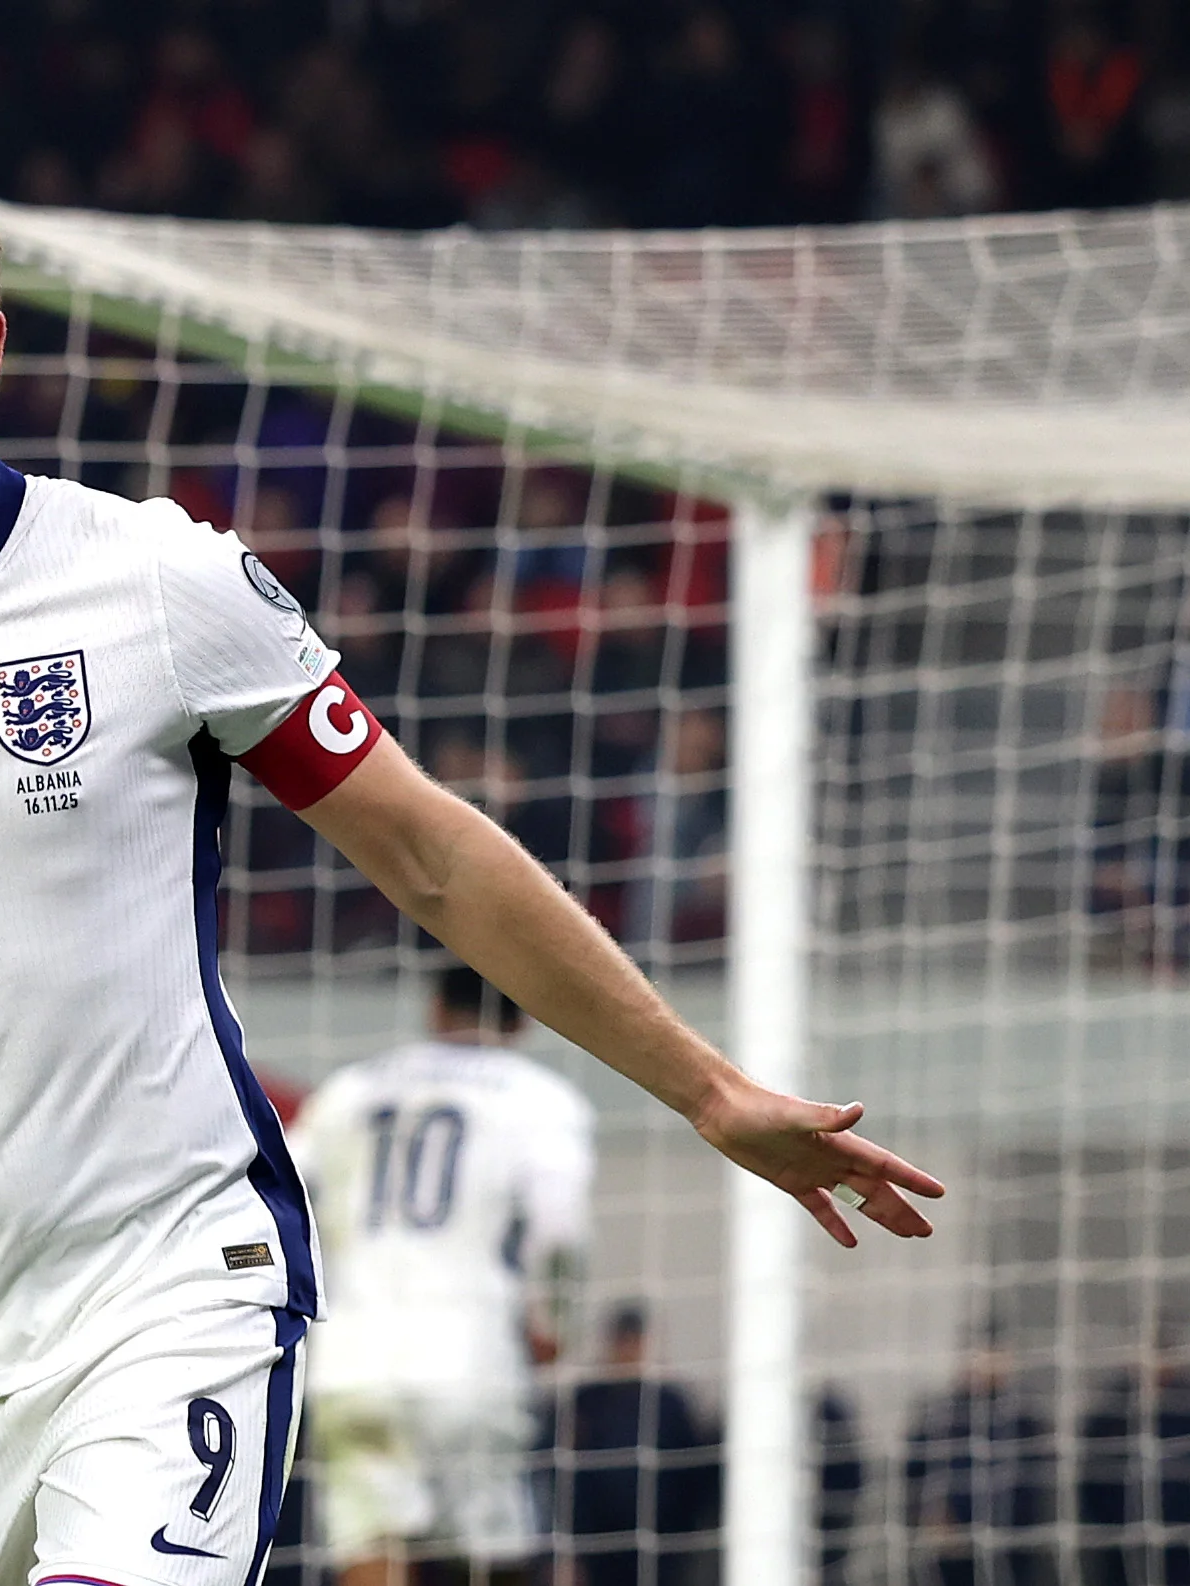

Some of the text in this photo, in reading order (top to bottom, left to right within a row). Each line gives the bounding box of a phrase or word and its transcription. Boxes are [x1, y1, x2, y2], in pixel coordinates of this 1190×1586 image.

[308, 685, 369, 755] C
[16, 770, 82, 794] ALBANIA
[24, 792, 79, 815] 16.11.25
[365, 1103, 467, 1234] 10
[187, 1397, 236, 1523] 9
